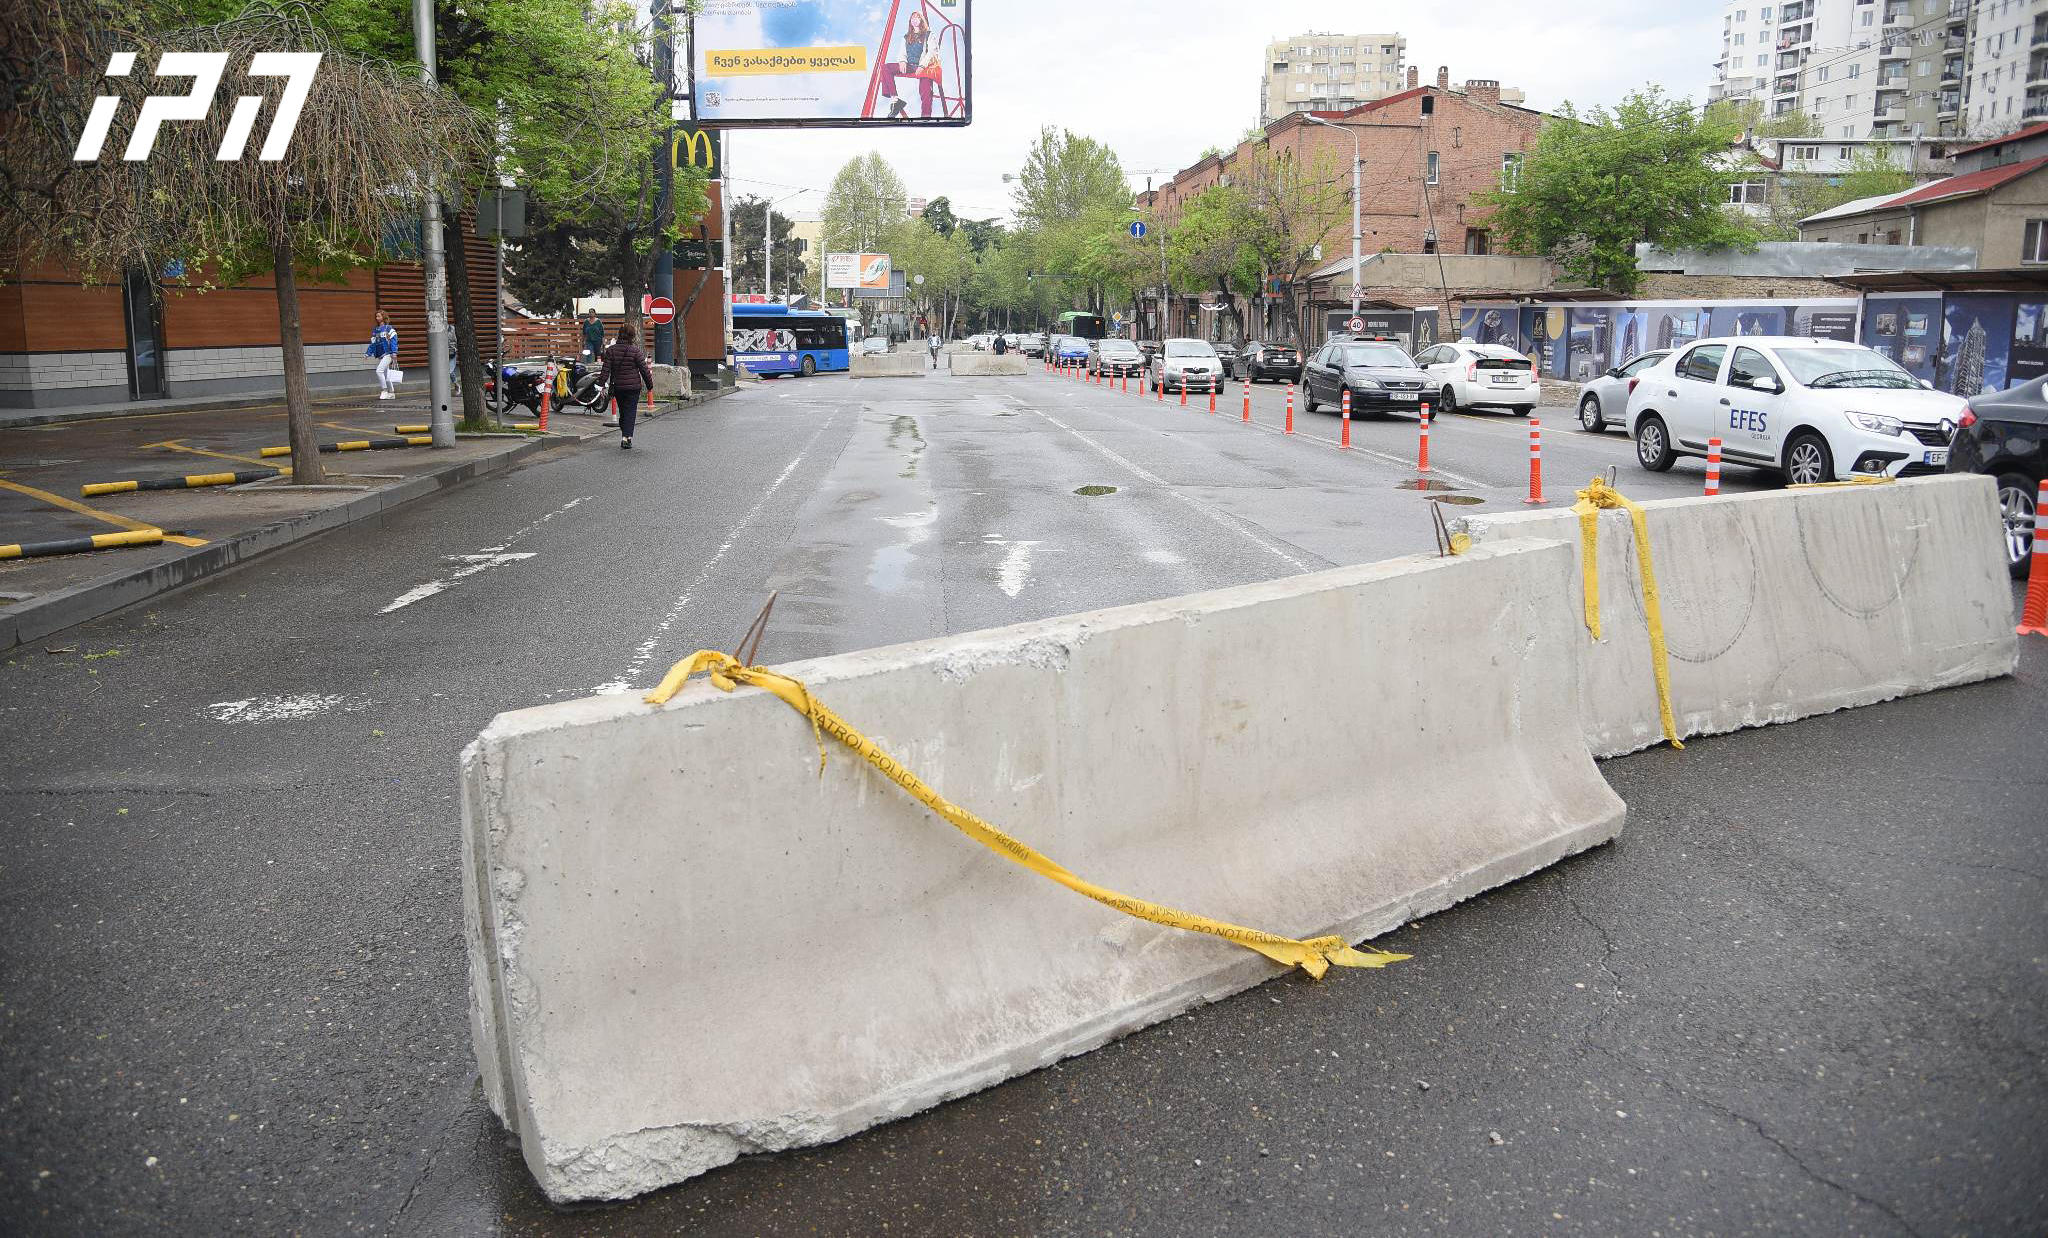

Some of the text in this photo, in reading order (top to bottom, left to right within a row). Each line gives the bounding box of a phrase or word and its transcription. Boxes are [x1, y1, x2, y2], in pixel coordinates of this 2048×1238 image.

[713, 55, 856, 67] ჩვენ ვასაქმებთ ყველას
[1352, 321, 1361, 329] 40
[1730, 409, 1767, 432] EFES
[1214, 928, 1243, 940] NOT
